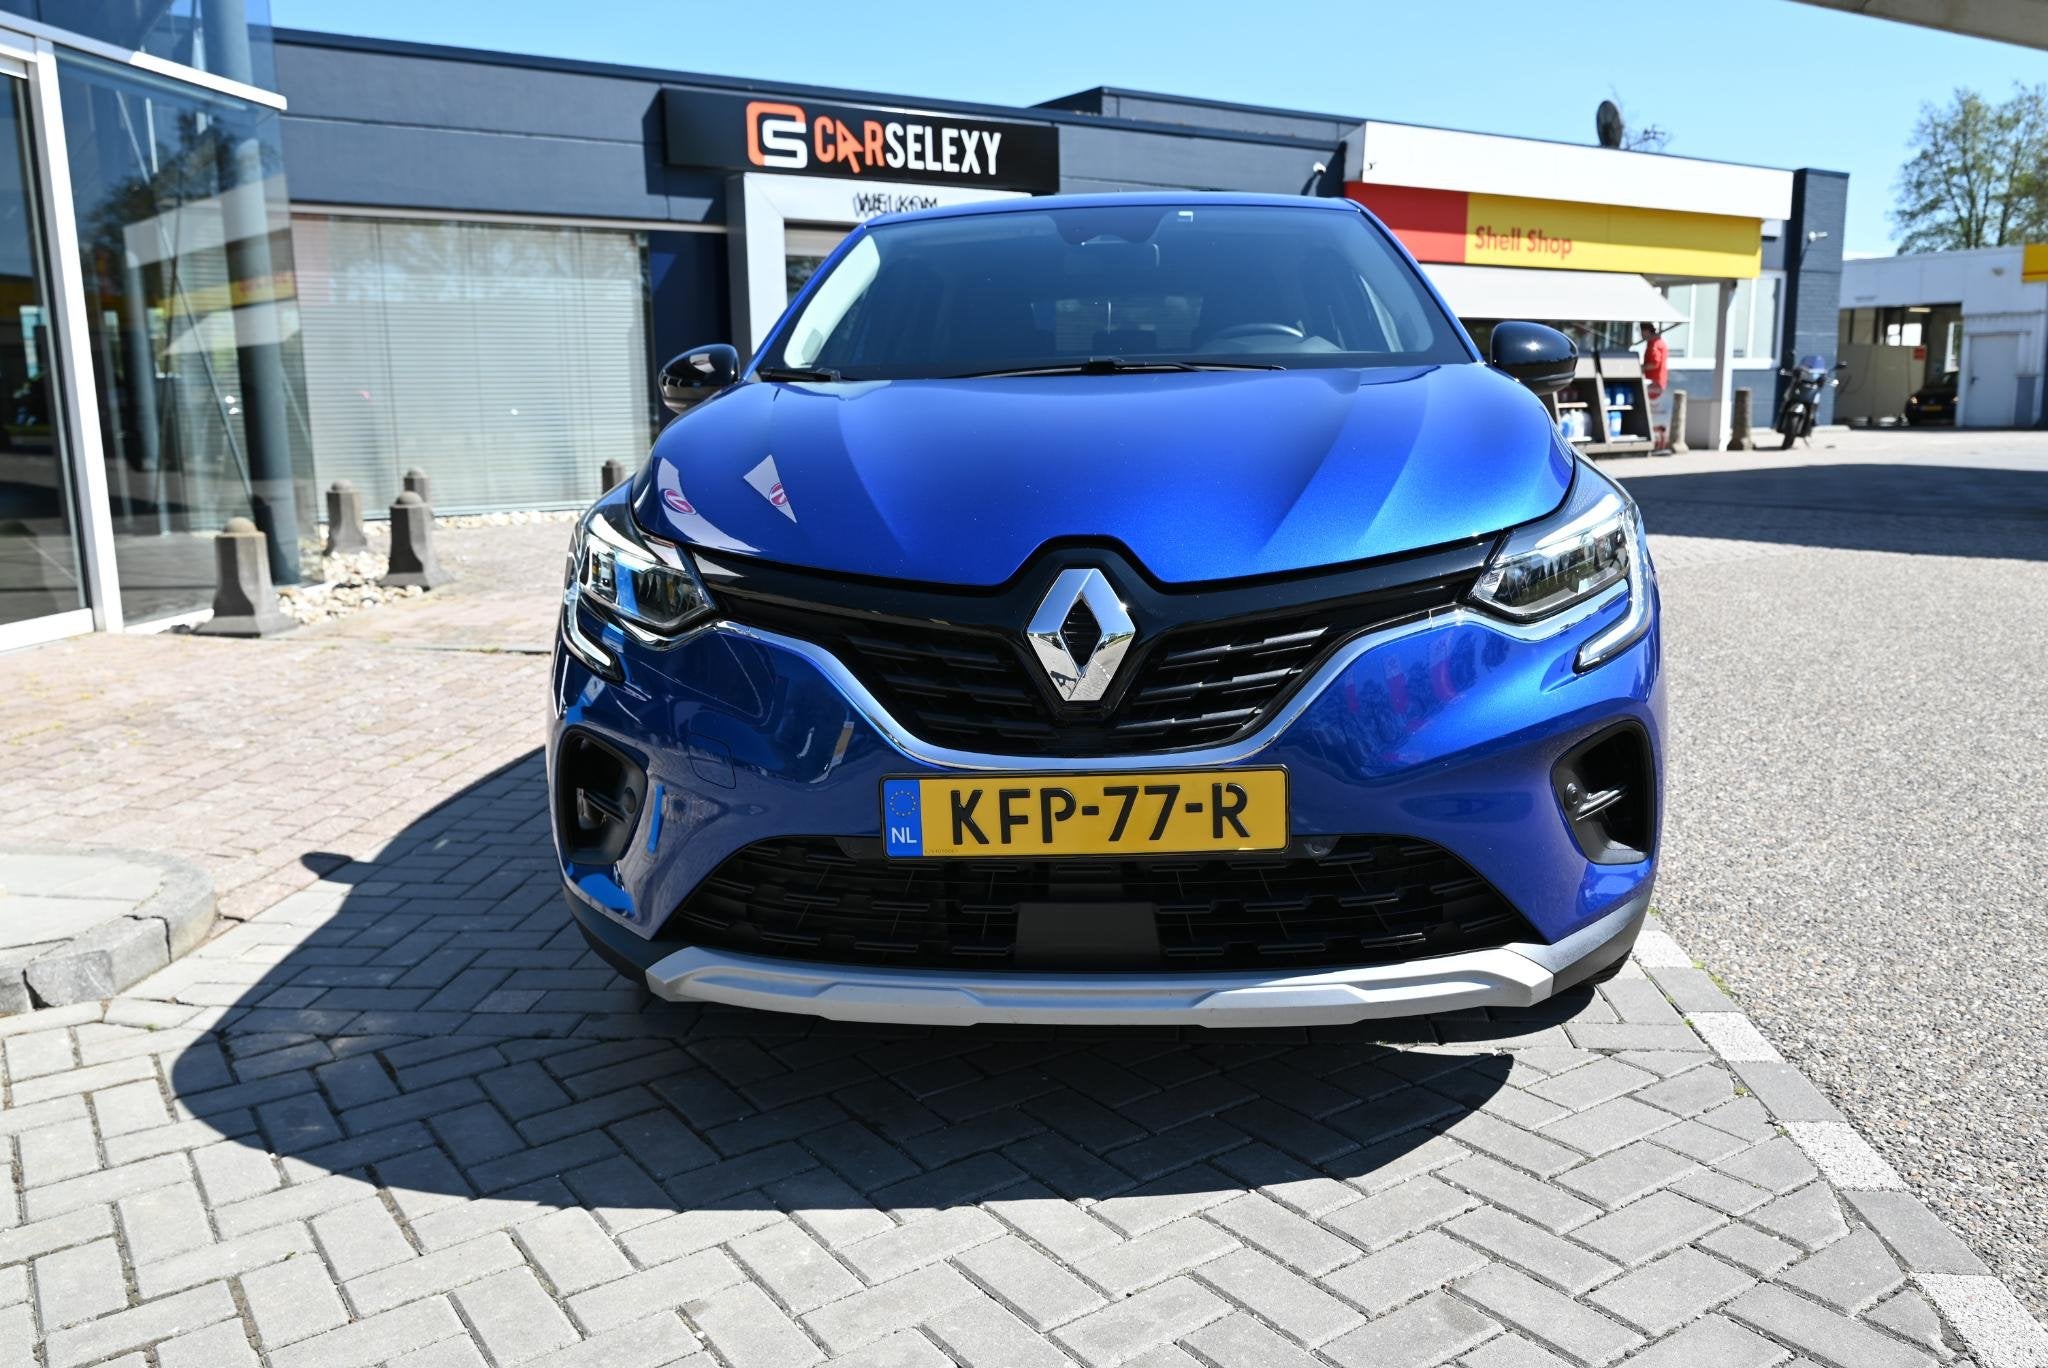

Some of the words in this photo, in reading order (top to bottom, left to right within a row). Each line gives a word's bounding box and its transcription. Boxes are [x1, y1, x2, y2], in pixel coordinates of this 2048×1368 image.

[813, 115, 1002, 176] CARSELEXY
[1475, 225, 1521, 251] Shell
[1527, 228, 1572, 260] Shop
[891, 827, 917, 845] NL
[950, 783, 1250, 846] KFP-77-R
